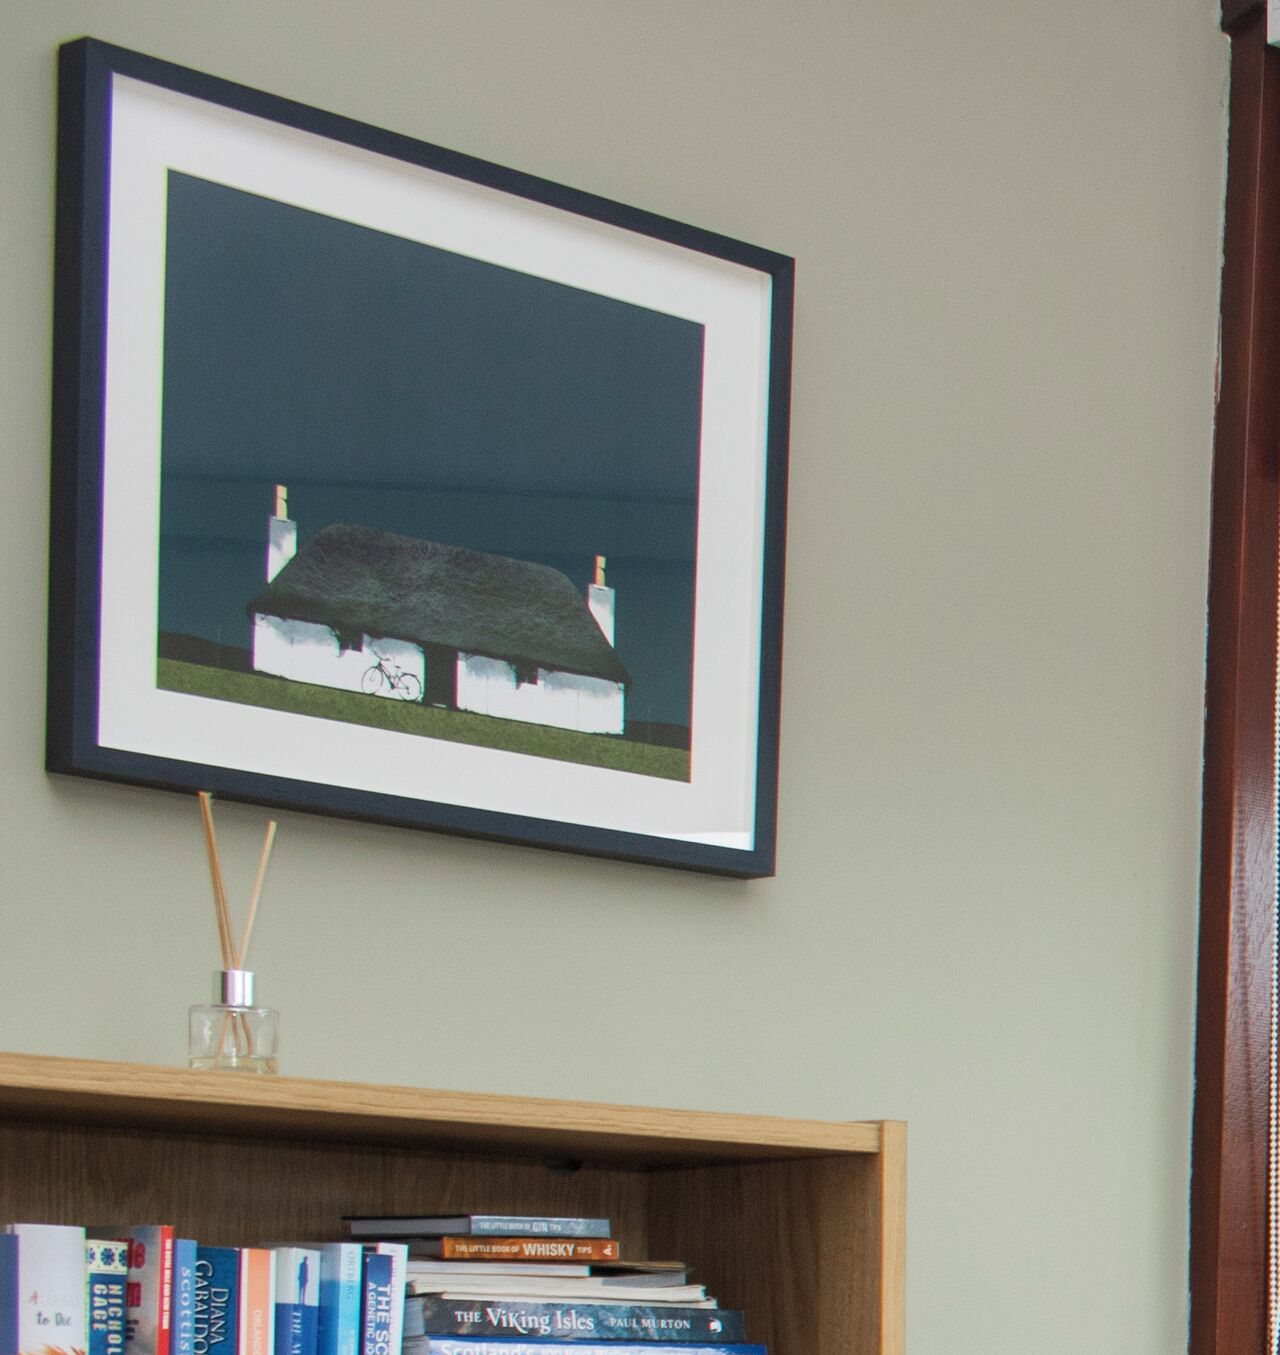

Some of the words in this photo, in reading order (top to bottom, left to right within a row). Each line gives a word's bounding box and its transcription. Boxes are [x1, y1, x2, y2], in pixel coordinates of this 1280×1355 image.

[532, 1221, 548, 1232] GIN
[455, 1244, 468, 1252] THE
[469, 1244, 490, 1253] LITTLE
[492, 1245, 509, 1253] BOOK
[522, 1243, 577, 1257] WHISKY
[577, 1246, 592, 1254] TIPS
[93, 1284, 107, 1332] GAGE
[209, 1287, 229, 1345] DIANA
[365, 1291, 376, 1339] GENETIC
[376, 1284, 391, 1323] THE
[291, 1311, 303, 1336] THE
[454, 1311, 481, 1323] THE
[554, 1309, 595, 1331] Isles
[609, 1318, 639, 1328] PAUL
[641, 1318, 691, 1330] MURTON
